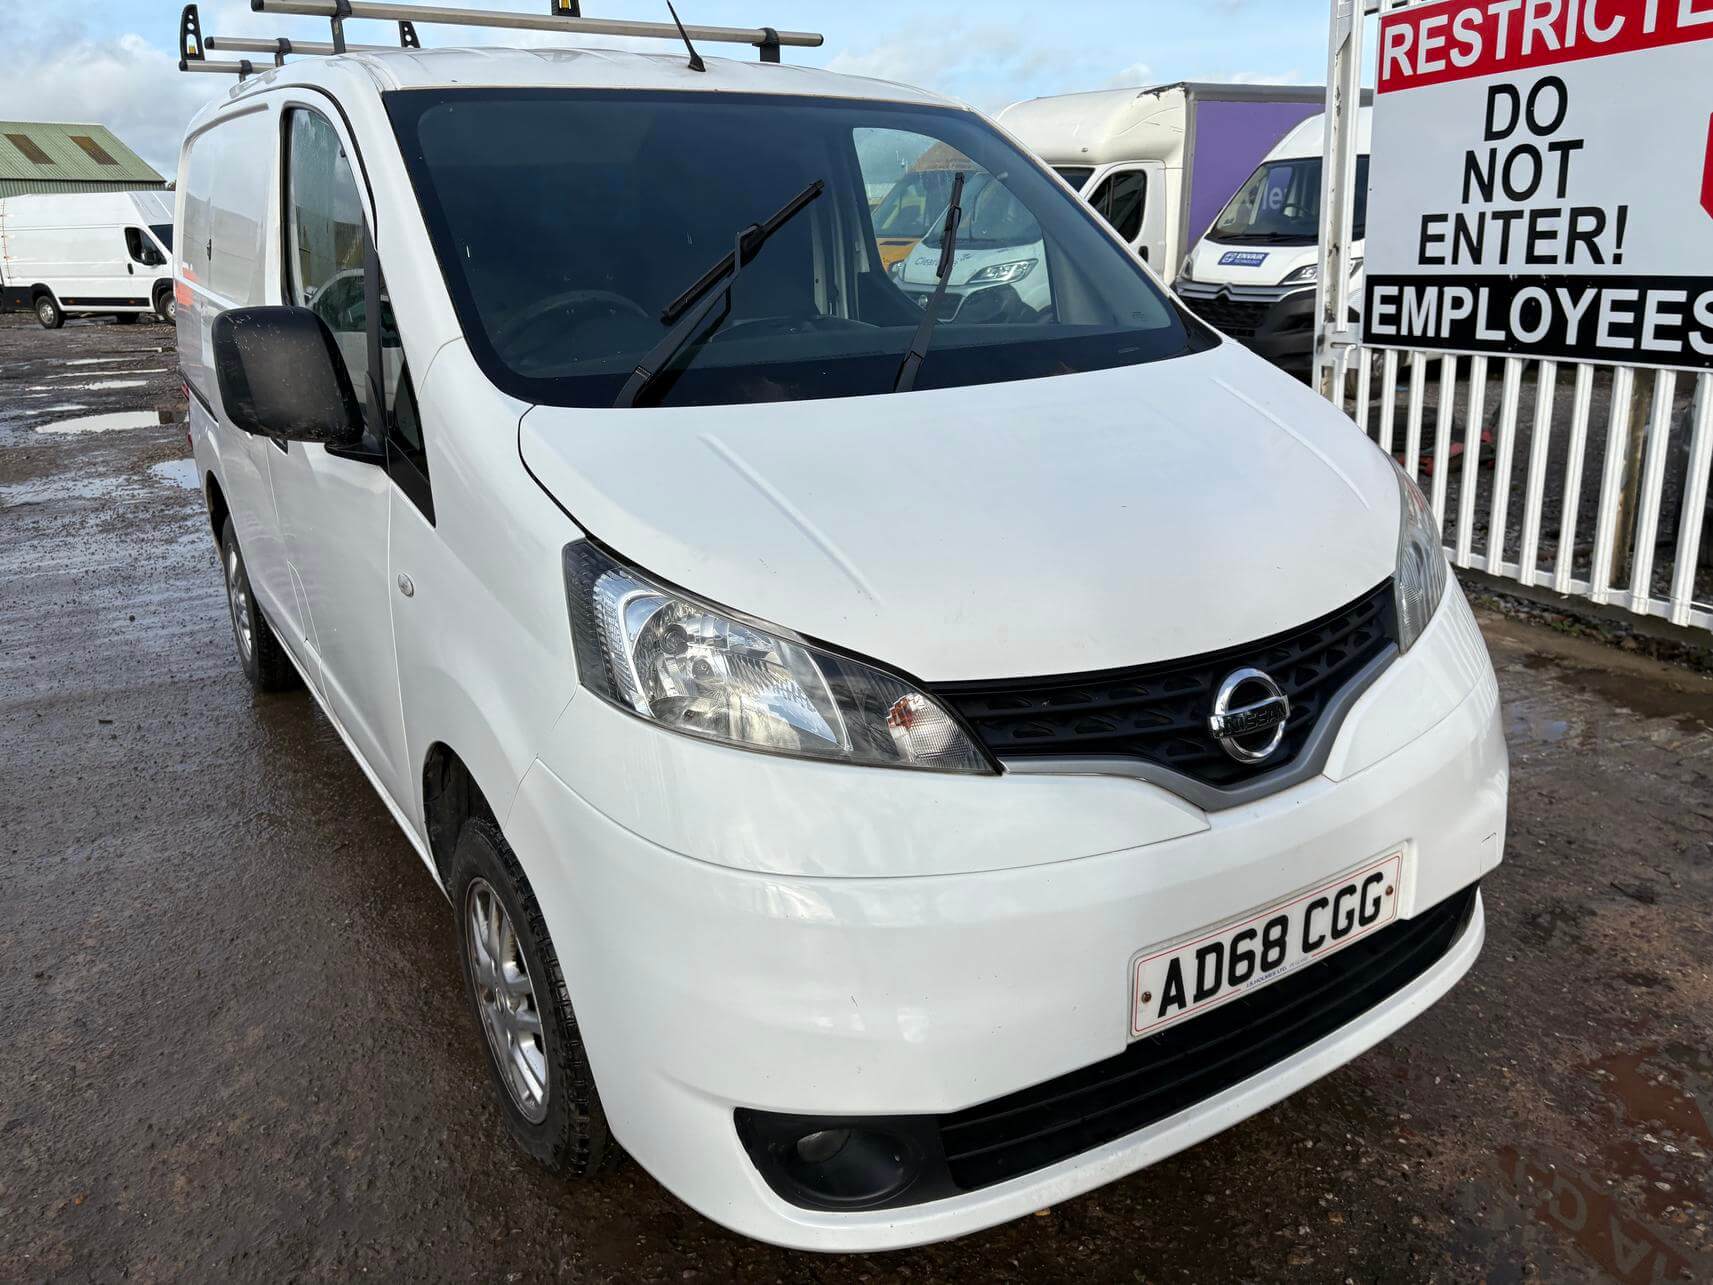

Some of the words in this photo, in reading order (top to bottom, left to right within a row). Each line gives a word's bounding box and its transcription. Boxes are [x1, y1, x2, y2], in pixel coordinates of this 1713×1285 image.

[1484, 75, 1568, 142] DO
[1462, 139, 1584, 204] NOT
[1418, 205, 1628, 265] ENTER!
[1371, 286, 1713, 355] EMPLOYEES
[1157, 914, 1289, 1018] AD68
[1302, 871, 1384, 953] CGG
